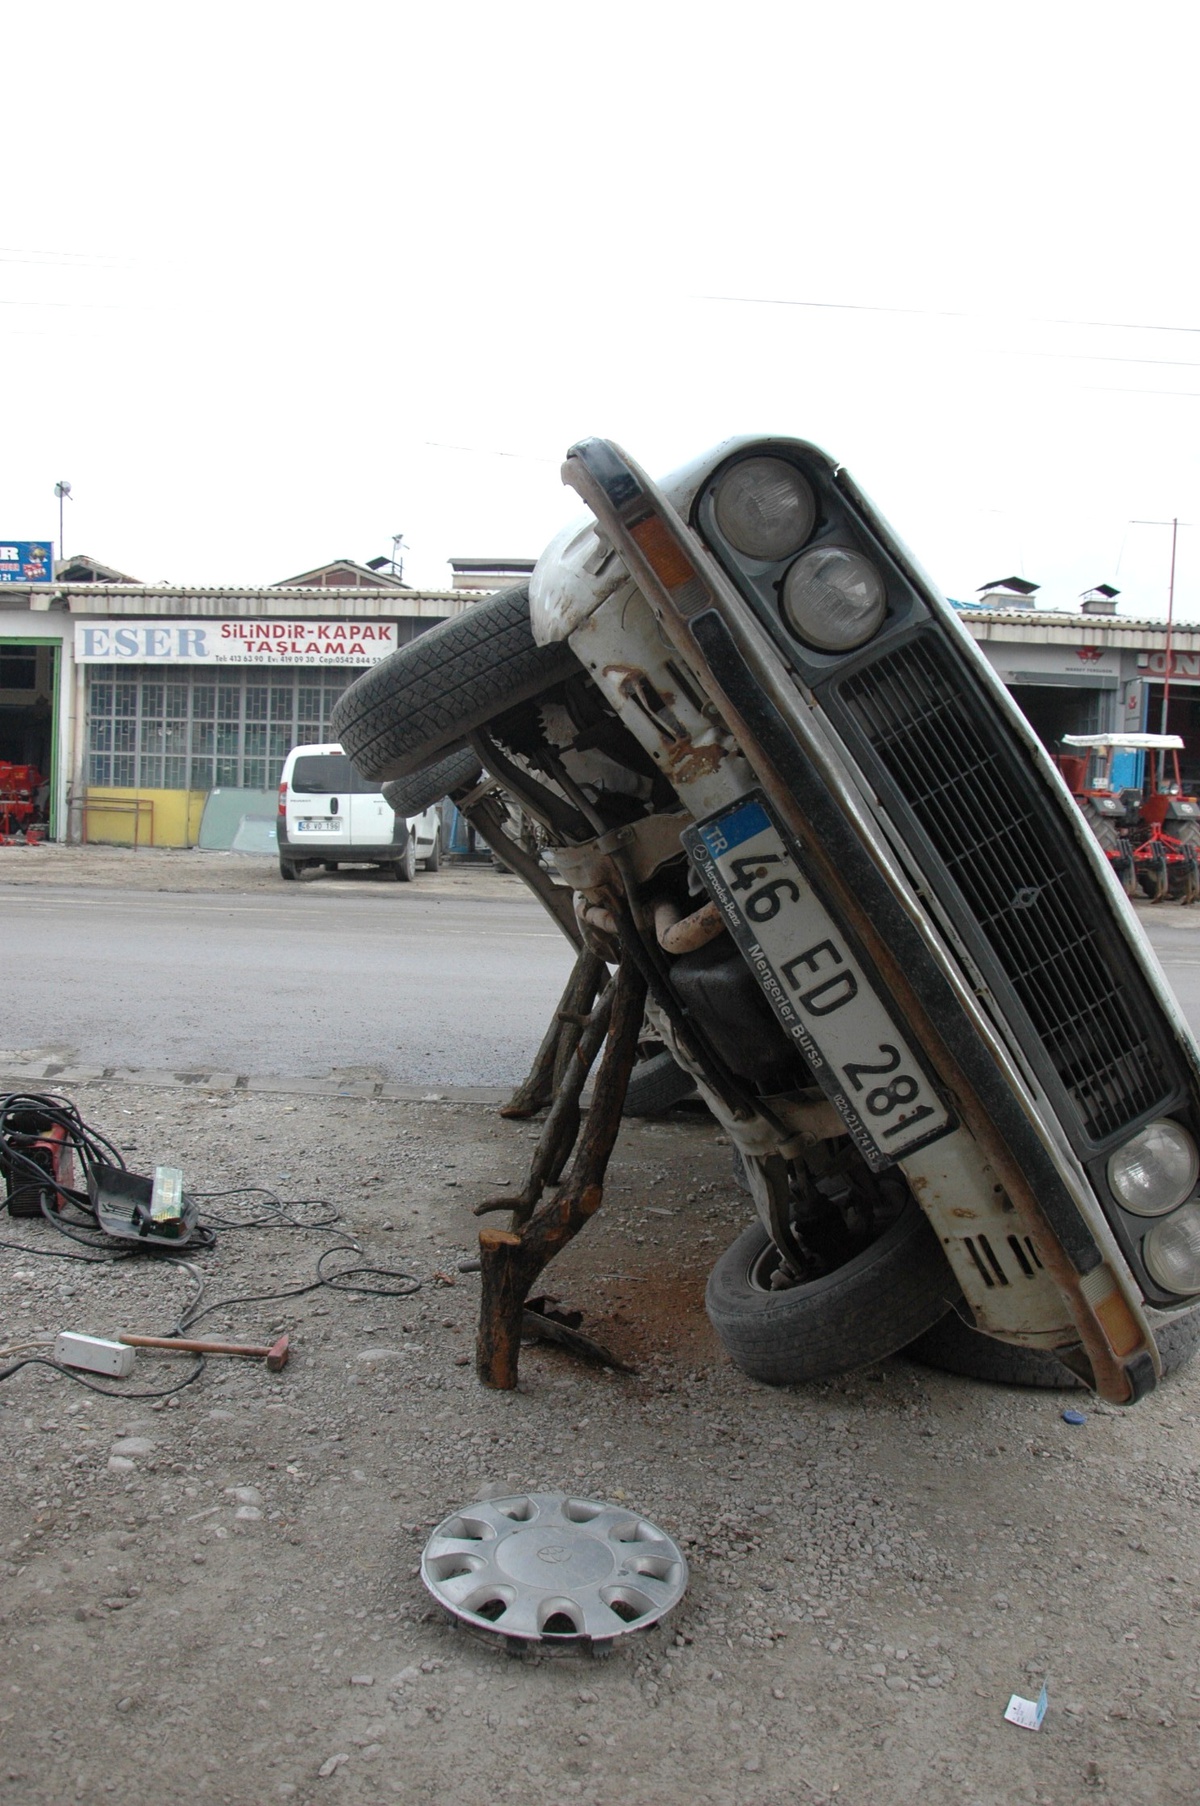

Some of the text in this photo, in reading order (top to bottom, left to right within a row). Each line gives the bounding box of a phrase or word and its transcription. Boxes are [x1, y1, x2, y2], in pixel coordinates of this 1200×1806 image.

[81, 628, 210, 657] ESER
[243, 641, 366, 656] TAŞLAMA
[706, 826, 728, 854] TR
[702, 861, 741, 927] Mercedes-Benz
[729, 854, 935, 1139] 46 ED 281
[748, 943, 824, 1069] Mengerler Bursa
